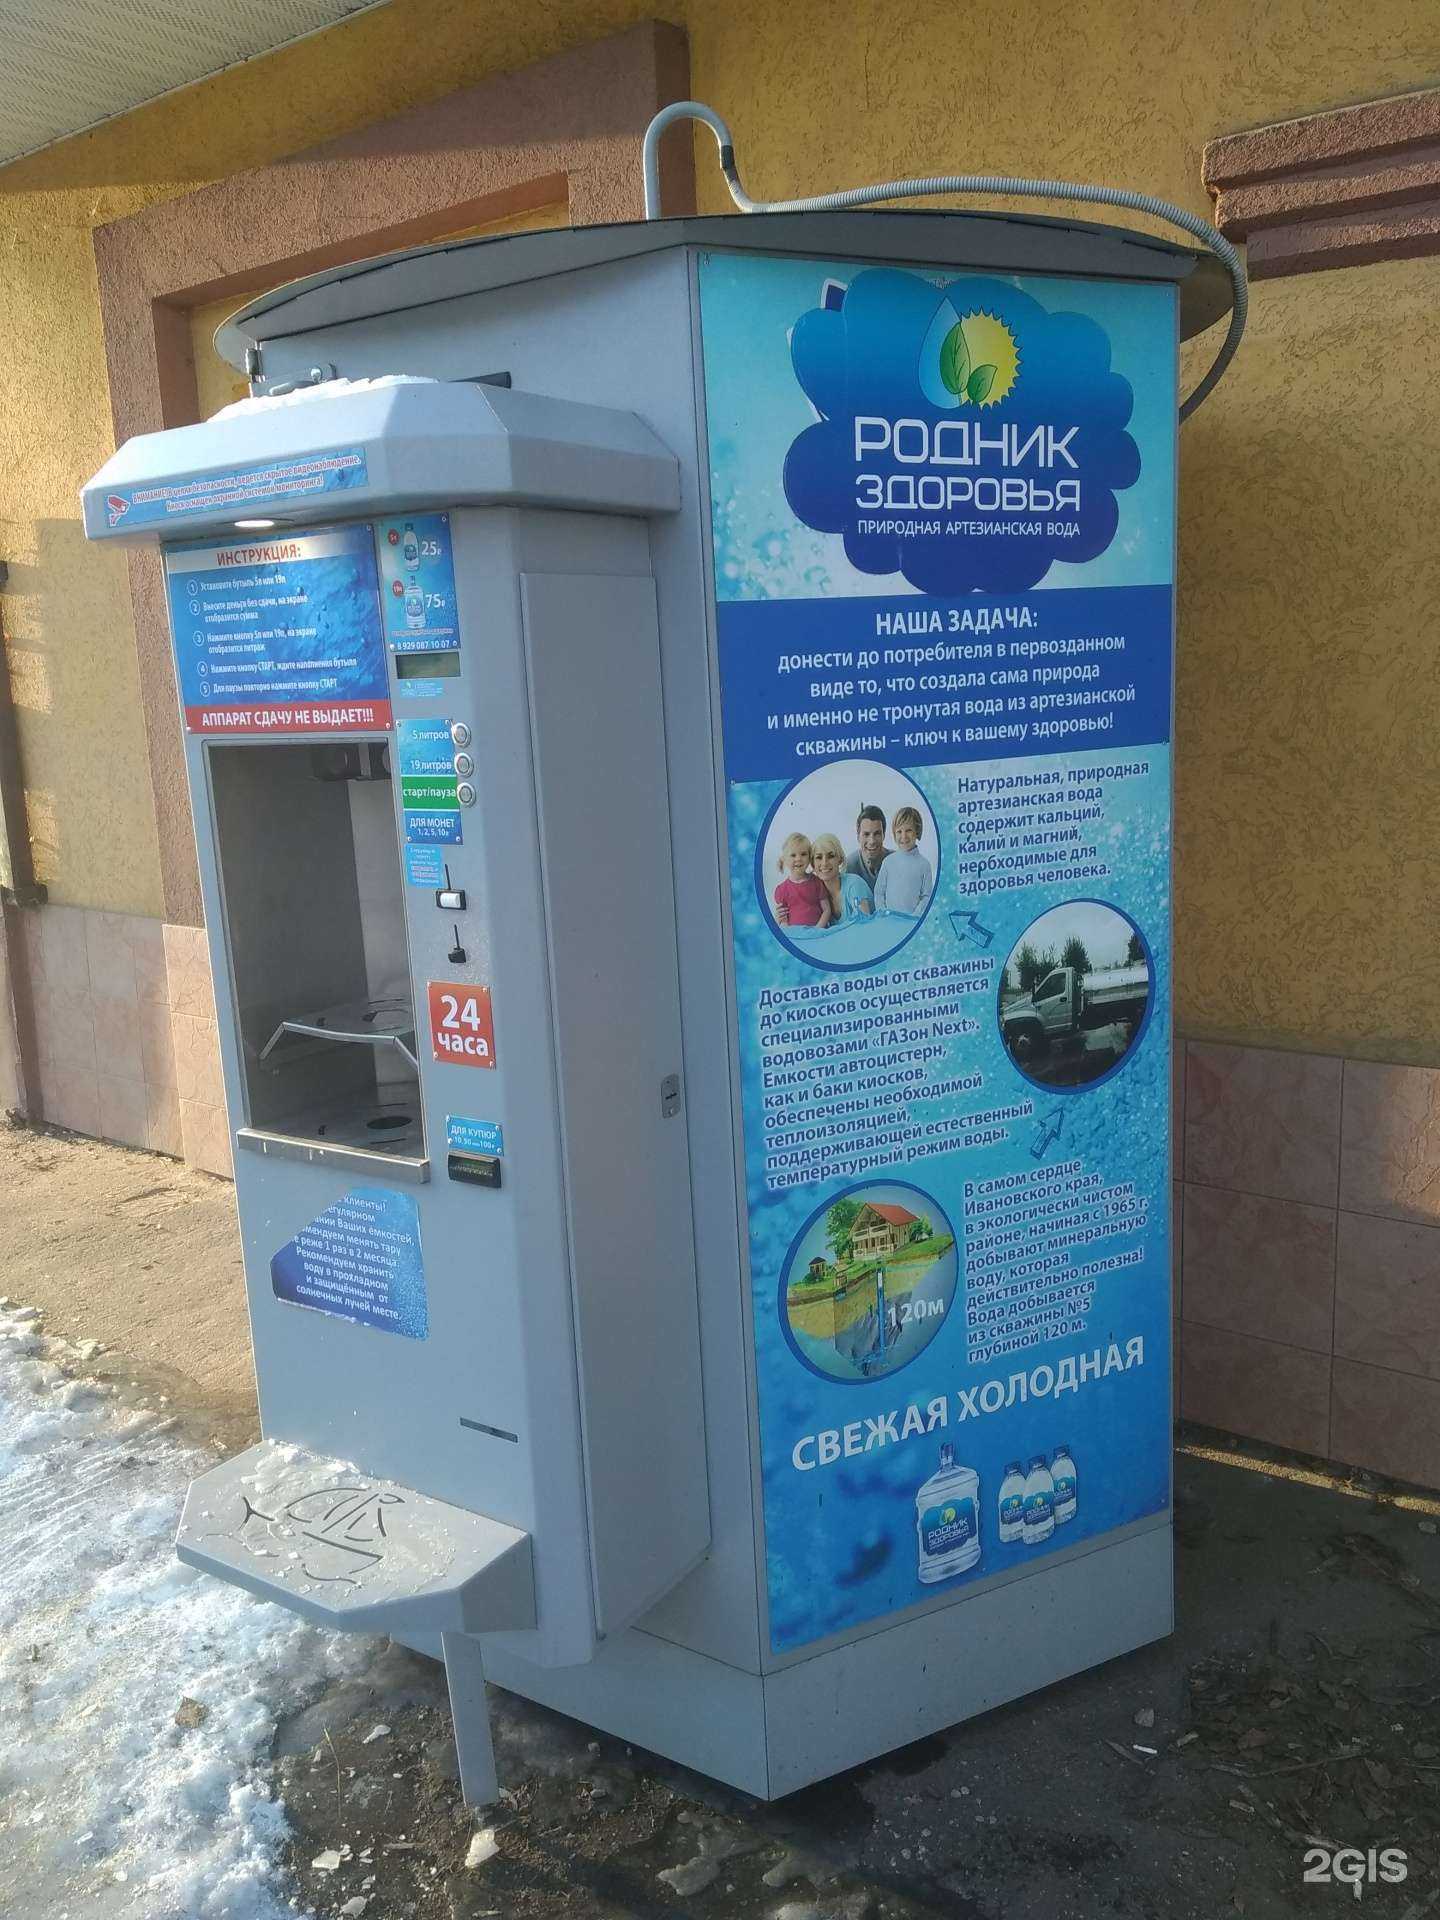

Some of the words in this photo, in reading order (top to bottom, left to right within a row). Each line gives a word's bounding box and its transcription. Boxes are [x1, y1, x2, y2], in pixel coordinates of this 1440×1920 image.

[854, 416, 1080, 468] РОДНИК
[855, 474, 1081, 512] ЗДОРОВЬЯ
[857, 520, 941, 536] ПРИРОДНАЯ
[945, 521, 1042, 536] АРТЕЗИАНСКАЯ
[1046, 521, 1080, 536] ВОДА
[217, 544, 301, 566] ИНСТРУКЦИЯ:
[876, 612, 942, 635] НАША
[948, 607, 1039, 635] ЗАДАЧА:
[403, 641, 415, 649] 929
[441, 640, 450, 648] 07
[778, 650, 853, 673] донести
[857, 648, 879, 669] до
[884, 642, 993, 665] потребителя
[1010, 635, 1125, 656] первозданном
[810, 679, 854, 698] виде
[857, 677, 882, 696] то,
[886, 675, 915, 692] что
[920, 671, 986, 690] создала
[990, 667, 1028, 684] сама
[1032, 663, 1100, 684] природа
[202, 712, 251, 727] АППАРАТ
[254, 711, 292, 727] СДАЧУ
[295, 711, 310, 724] НЕ
[312, 708, 374, 726] ВЫДАЕТ!!!
[783, 710, 853, 728] именно
[857, 708, 878, 723] не
[883, 700, 960, 725] тронутая
[964, 698, 1004, 716] вода
[1008, 695, 1025, 711] из
[1029, 684, 1136, 711] артезианской
[419, 731, 449, 742] литров
[796, 737, 886, 757] скважины
[904, 730, 947, 747] ключ
[965, 723, 1027, 742] вашему
[1031, 713, 1113, 738] здоровью!
[420, 761, 452, 771] литров
[958, 771, 1065, 793] Натуральная,
[1068, 762, 1149, 784] природная
[403, 788, 456, 799] старт/пауза
[958, 791, 1064, 817] артезианская
[1068, 787, 1103, 801] вода
[410, 818, 425, 828] ДЛЯ
[427, 818, 455, 827] МОНЕТ
[958, 814, 1035, 834] содержит
[1037, 803, 1105, 825] кальций,
[959, 836, 1005, 854] калий
[1023, 826, 1082, 847] магний,
[959, 848, 1067, 874] необходимые
[1070, 846, 1097, 863] для
[959, 874, 1034, 896] здоровья
[1038, 865, 1111, 883] человека.
[759, 981, 840, 1010] Доставка
[844, 973, 888, 994] воды
[892, 972, 910, 985] от
[913, 957, 994, 982] скважины
[441, 995, 481, 1032] 24
[760, 1014, 783, 1030] до
[787, 1000, 856, 1023] киосков
[860, 977, 989, 1010] осуществляется
[761, 1002, 960, 1048] специализированными
[437, 1032, 489, 1057] часа
[762, 1038, 868, 1067] водовозами
[763, 1064, 835, 1088] Емкости
[839, 1046, 948, 1075] автоцистерн,
[764, 1089, 794, 1109] как
[813, 1080, 853, 1100] баки
[857, 1067, 928, 1091] киосков,
[765, 1097, 869, 1129] обеспечены
[873, 1072, 983, 1109] необходимой
[451, 1125, 466, 1134] ДЛЯ
[468, 1127, 496, 1139] КУПЮР
[766, 1109, 911, 1149] теплоизоляцией,
[767, 1119, 923, 1170] поддерживающей
[926, 1099, 1034, 1136] естественный
[768, 1146, 903, 1190] температурный
[907, 1137, 961, 1163] режим
[964, 1128, 1009, 1150] воды.
[978, 1175, 1027, 1194] самом
[1030, 1160, 1082, 1184] сердце
[965, 1183, 1062, 1216] Ивановского
[1065, 1174, 1103, 1192] края,
[977, 1197, 1079, 1233] экологически
[1083, 1183, 1134, 1205] чистом
[338, 1218, 366, 1234] Ваших
[369, 1227, 414, 1246] емкостей,
[966, 1229, 1026, 1256] районе,
[1029, 1213, 1090, 1239] начиная
[1104, 1200, 1136, 1218] 1965
[1139, 1196, 1148, 1210] г.
[301, 1237, 323, 1249] реже
[333, 1245, 346, 1255] раз
[364, 1252, 400, 1267] месяца.
[347, 1236, 378, 1249] менять
[381, 1243, 401, 1255] тару
[966, 1241, 1043, 1275] добывают
[1047, 1215, 1147, 1250] минеральную
[296, 1246, 356, 1270] Рекомендуем
[358, 1262, 394, 1278] хранить
[304, 1262, 324, 1276] воду
[333, 1269, 388, 1290] прохладном
[967, 1272, 1006, 1290] воду,
[1010, 1253, 1069, 1280] которая
[967, 1267, 1079, 1311] действительно
[1082, 1248, 1144, 1275] полезна!
[296, 1285, 342, 1304] солнечных
[345, 1300, 371, 1313] лучей
[378, 1294, 388, 1303] от
[888, 1299, 944, 1327] 120м
[967, 1308, 1005, 1327] Вода
[1008, 1281, 1095, 1318] добывается
[968, 1329, 986, 1344] из
[989, 1305, 1064, 1339] скважины
[1067, 1298, 1091, 1318] №5
[968, 1333, 1040, 1363] глубиной
[1044, 1322, 1069, 1340] 120
[1071, 1320, 1086, 1335] м.
[792, 1396, 948, 1471] СВЕЖАЯ
[958, 1336, 1145, 1423] ХОЛОДНАЯ
[928, 1517, 968, 1540] РОДНИК
